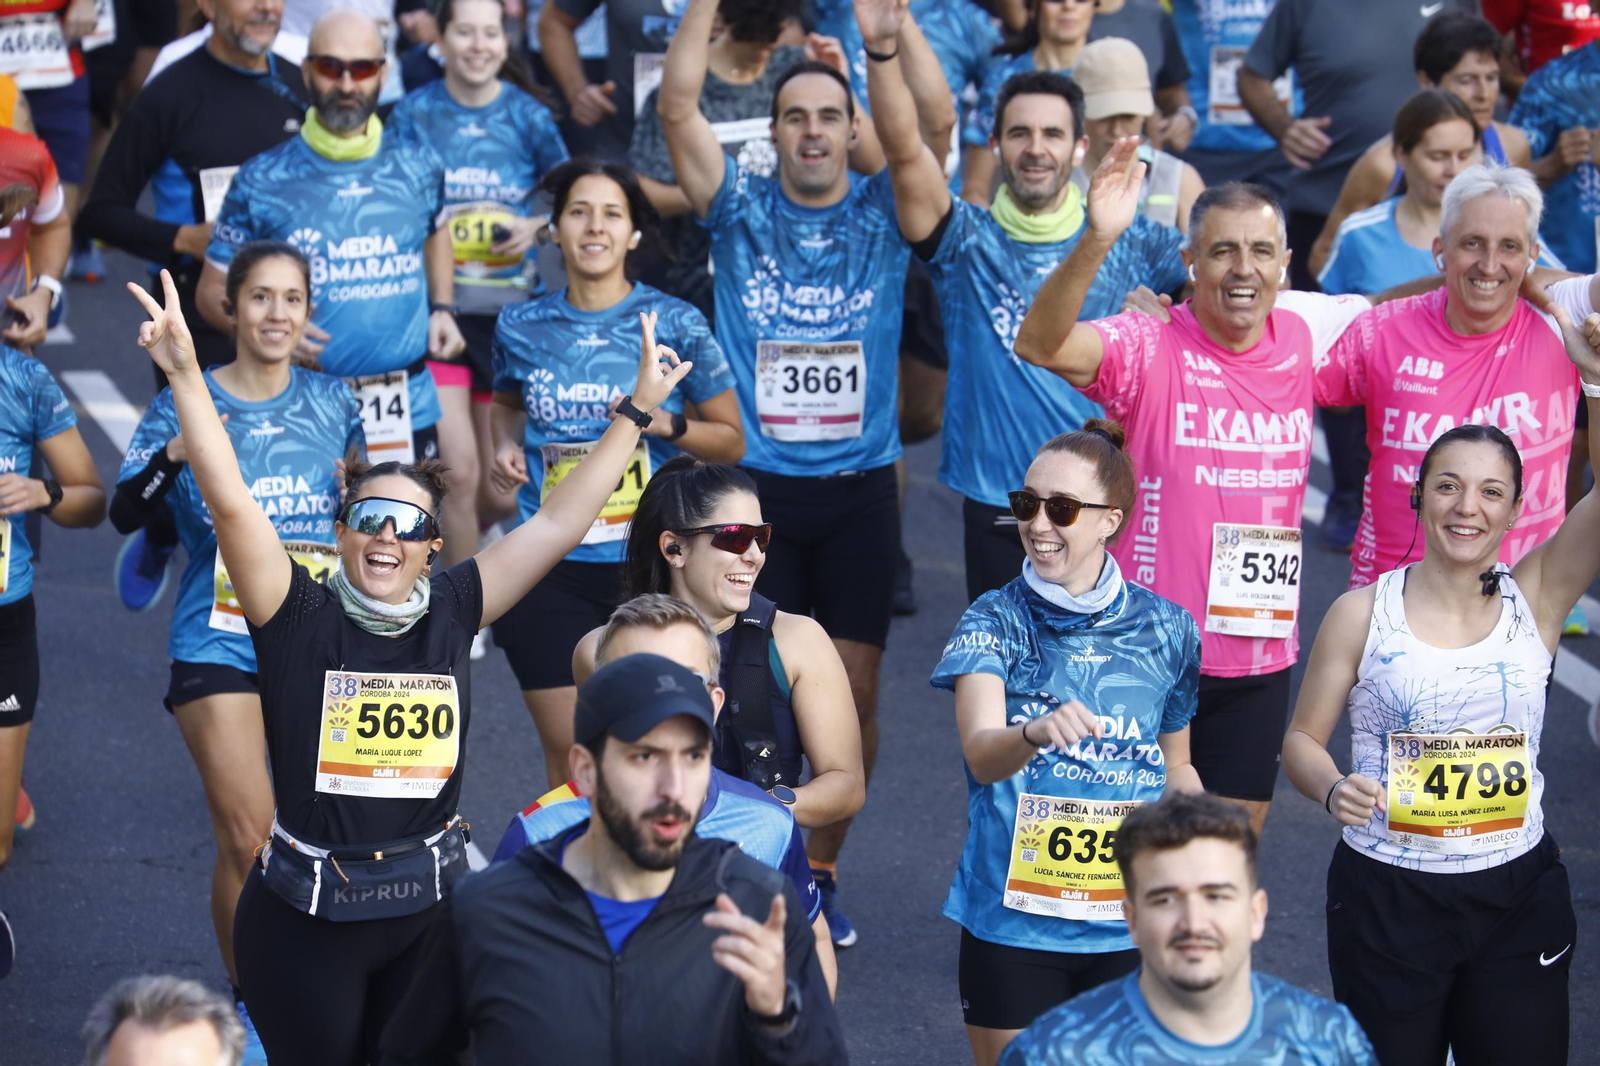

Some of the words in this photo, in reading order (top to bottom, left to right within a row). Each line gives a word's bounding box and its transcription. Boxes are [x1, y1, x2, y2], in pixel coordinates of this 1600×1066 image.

[327, 234, 399, 260] MEDIA
[1397, 355, 1445, 380] ABB
[782, 364, 858, 394] 3661
[556, 383, 624, 403] MEDIA
[526, 395, 557, 422] 38
[1131, 476, 1162, 588] aillant
[1219, 528, 1241, 547] 38
[1241, 530, 1270, 542] MEDIA
[1240, 552, 1299, 586] 5342
[329, 677, 357, 697] 38
[361, 679, 394, 690] MEDIA
[400, 677, 451, 691] MARATÓN
[393, 690, 410, 698] 2024
[356, 703, 454, 739] 5630
[355, 748, 379, 756] MARÍA
[381, 749, 402, 757] LUQUE
[403, 748, 423, 757] LÓPEZ
[1393, 738, 1420, 759] 38
[1423, 739, 1461, 751] MEDIA
[1465, 735, 1523, 750] MARATÓN
[1459, 750, 1476, 758] 2024
[1423, 761, 1527, 801] 4798
[1021, 799, 1050, 819] 38
[1053, 802, 1089, 816] MEDIA
[1411, 809, 1436, 817] MARÍA
[1482, 831, 1519, 845] IMDECO
[1055, 870, 1086, 880] SÁNCHEZ
[1060, 890, 1082, 900] CAJÓN
[1083, 892, 1090, 901] 6
